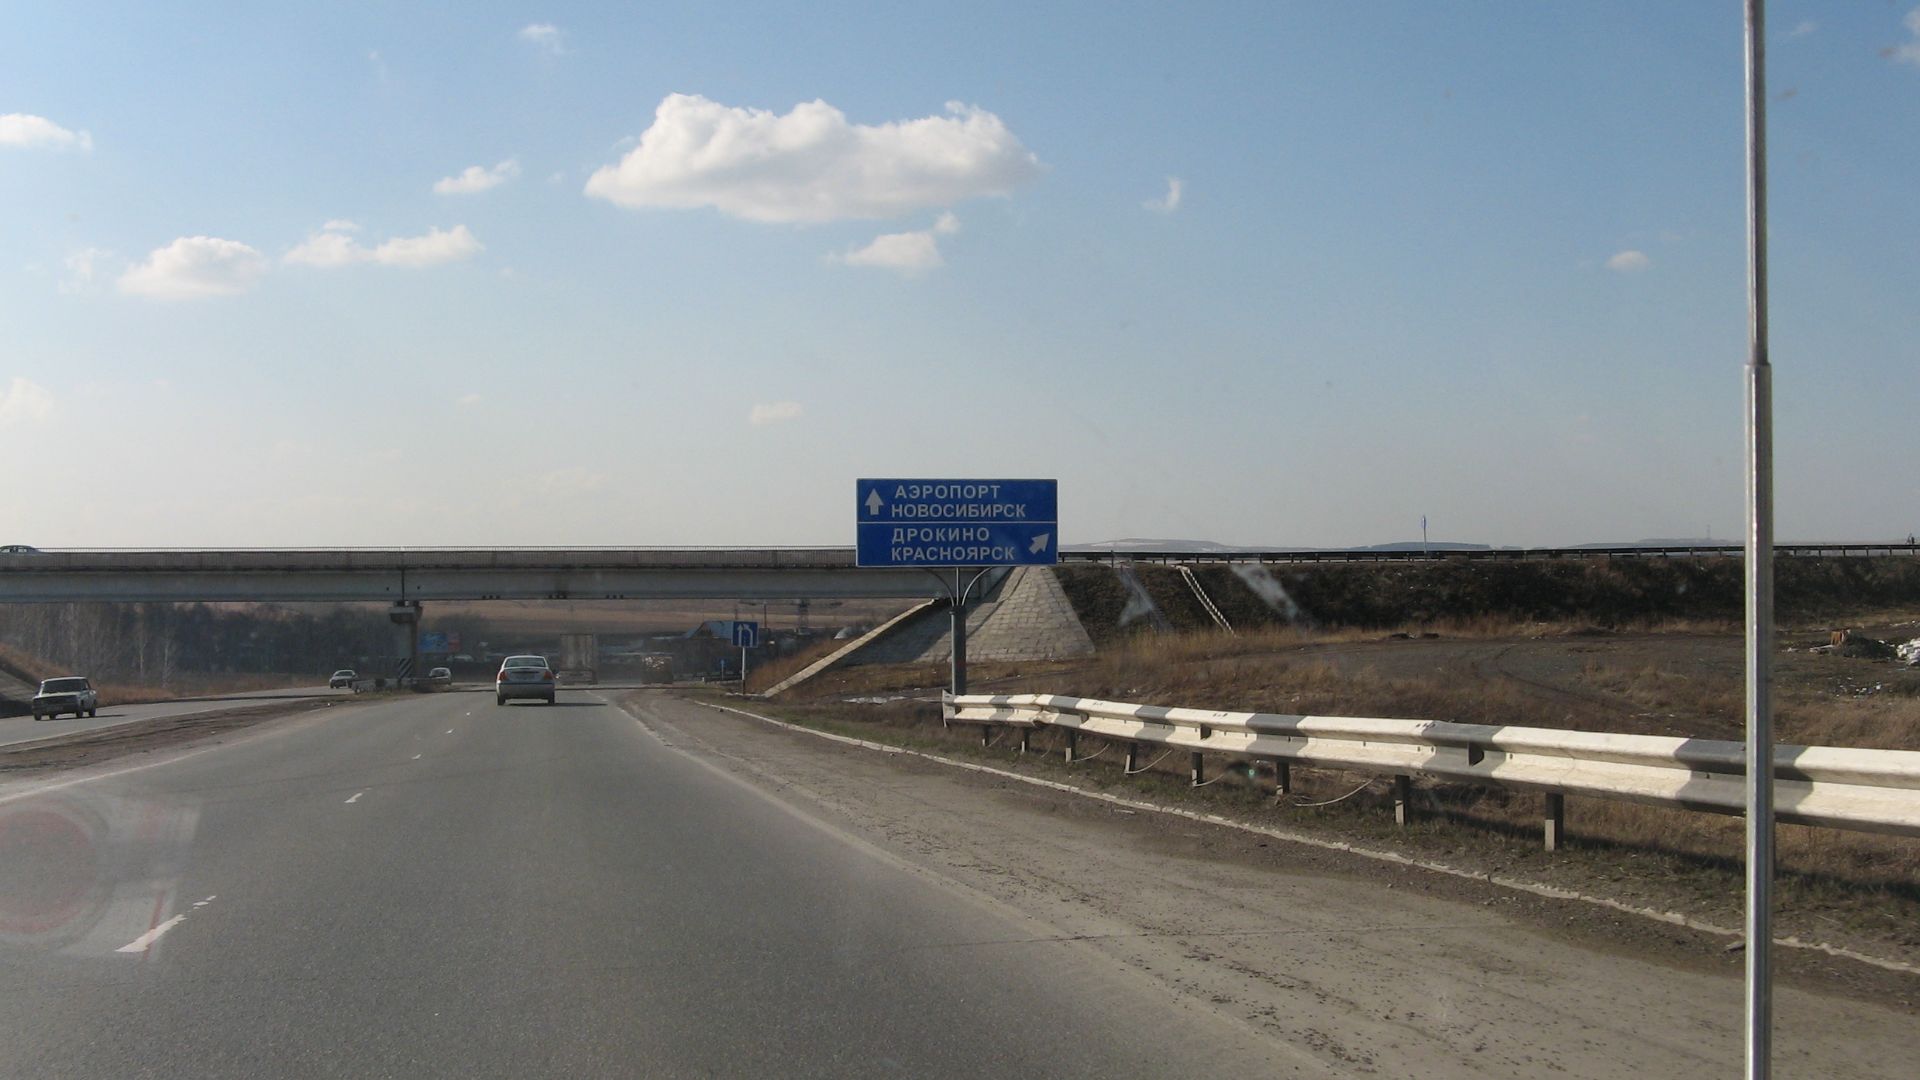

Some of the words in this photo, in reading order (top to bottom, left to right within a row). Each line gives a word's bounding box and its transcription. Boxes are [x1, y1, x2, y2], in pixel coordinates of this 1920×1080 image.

[895, 485, 1000, 499] АЭРОПОРТ
[891, 504, 1026, 518] НОВОСИБИРСК
[891, 527, 989, 544] ДРОКИНО
[891, 547, 1015, 561] КРАСНОЯРСК
